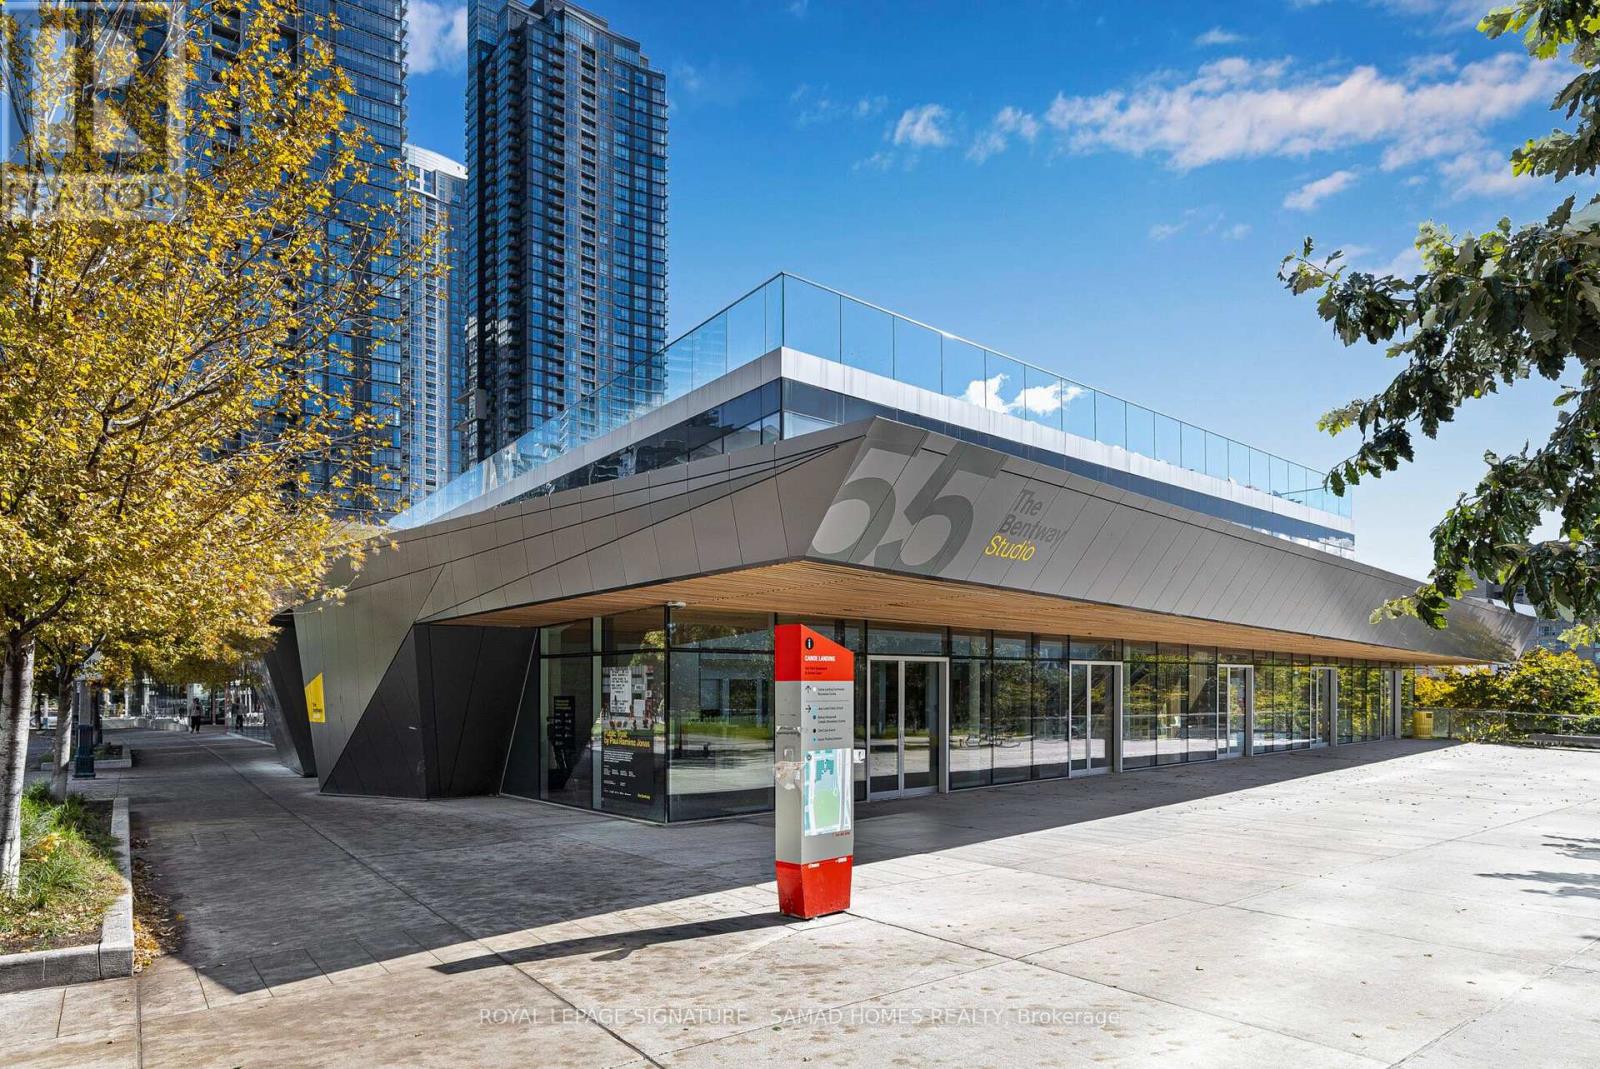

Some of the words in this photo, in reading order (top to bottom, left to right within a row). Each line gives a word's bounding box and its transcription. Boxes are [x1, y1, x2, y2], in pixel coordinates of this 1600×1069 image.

[1014, 489, 1043, 516] The
[999, 514, 1066, 544] Bentway
[985, 534, 1036, 561] Studio
